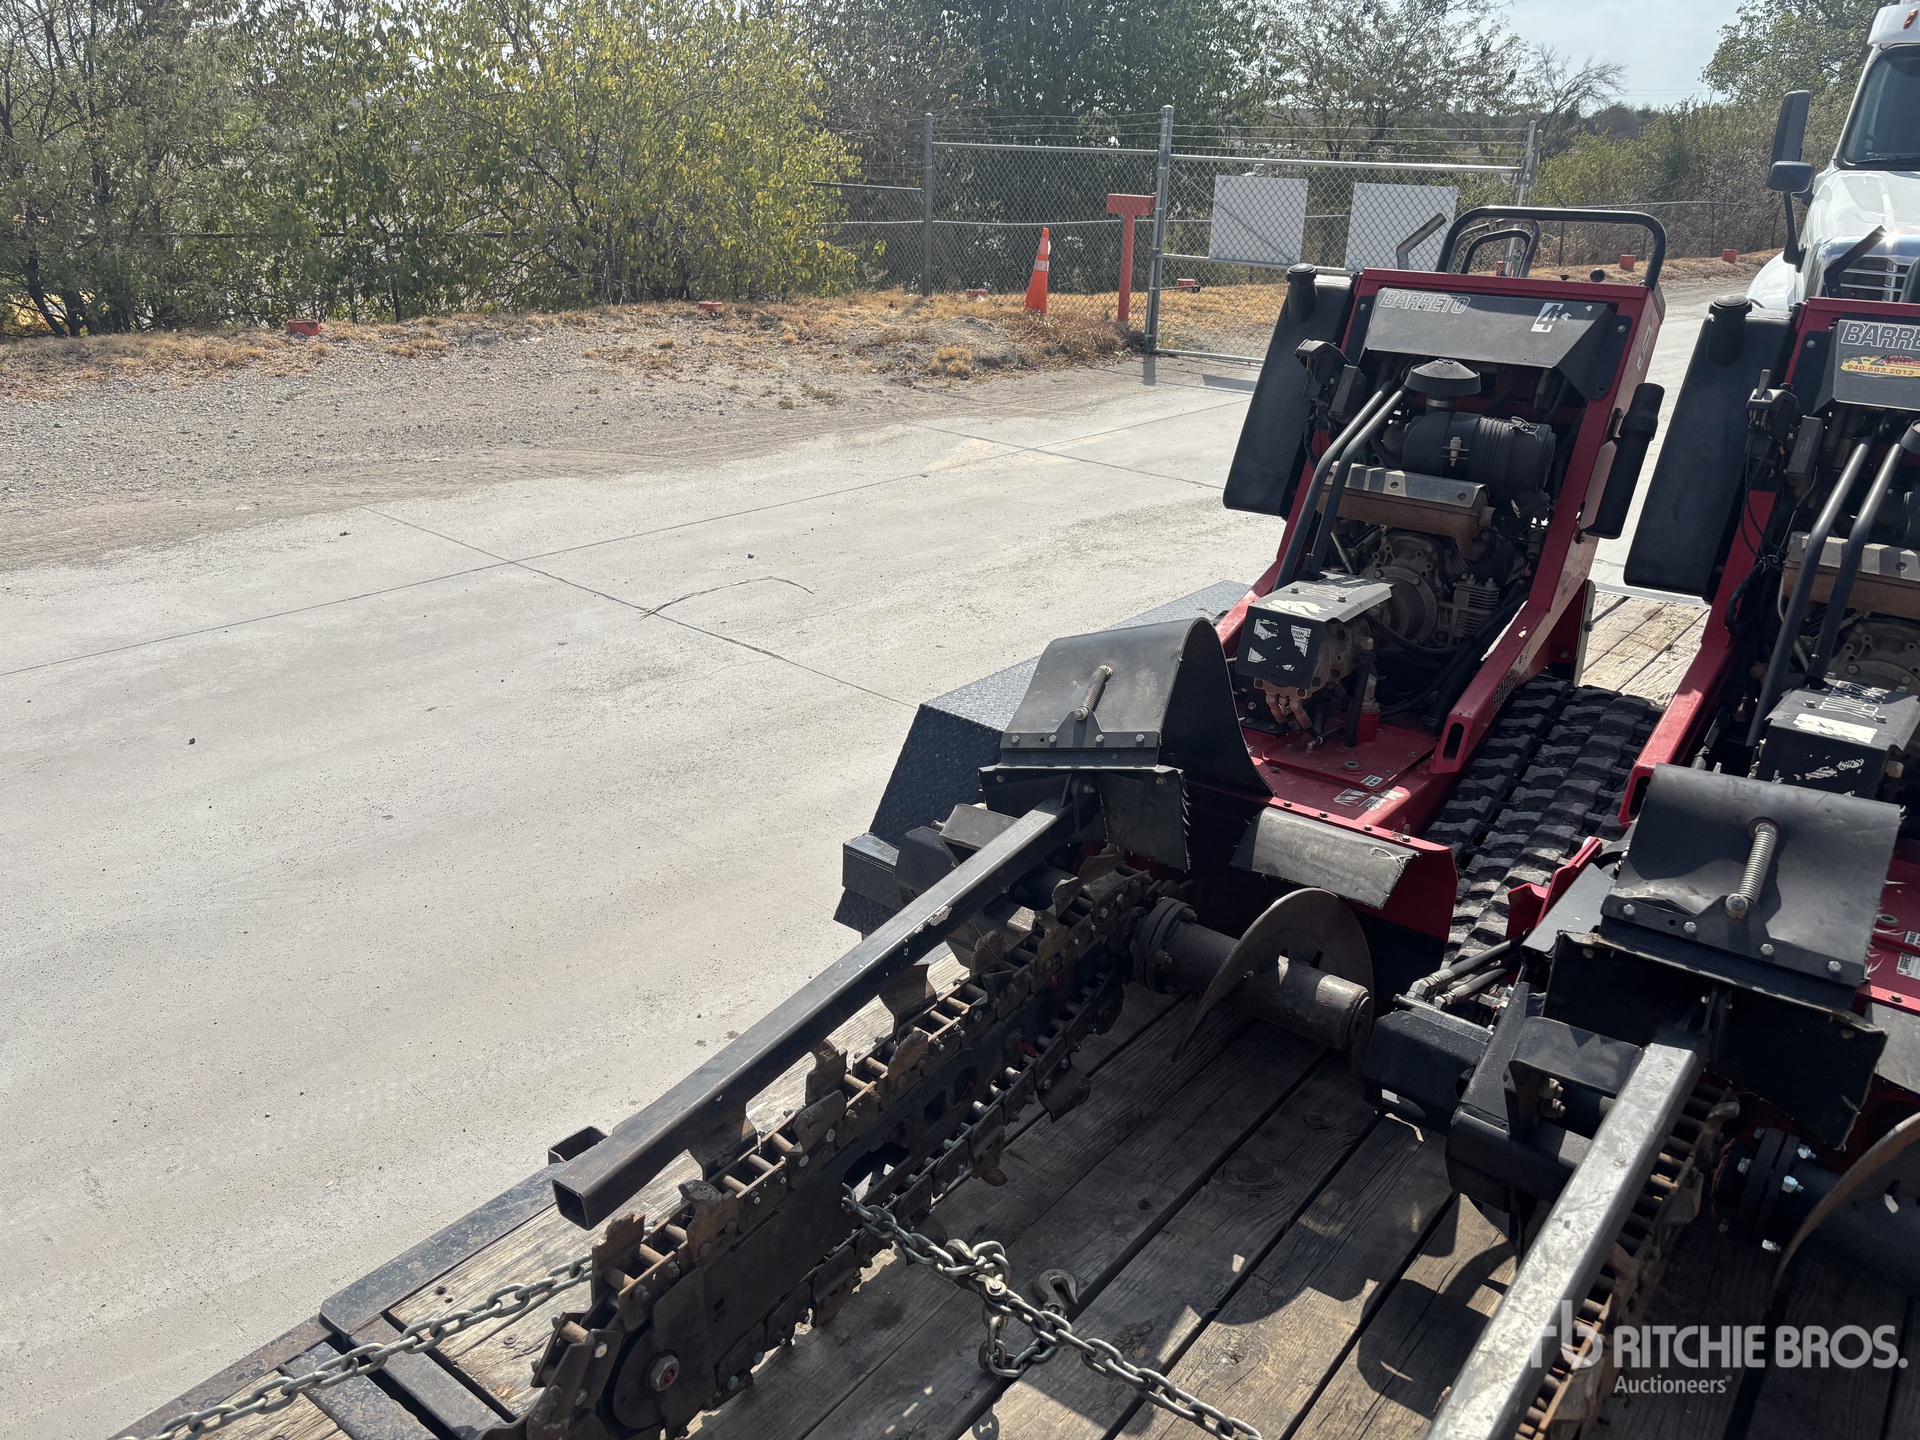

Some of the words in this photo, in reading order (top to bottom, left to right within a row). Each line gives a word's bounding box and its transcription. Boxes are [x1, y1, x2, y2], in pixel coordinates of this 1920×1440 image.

[1379, 290, 1471, 314] BARRETO
[1533, 303, 1562, 332] 4
[1846, 364, 1915, 376] 940.683.2012
